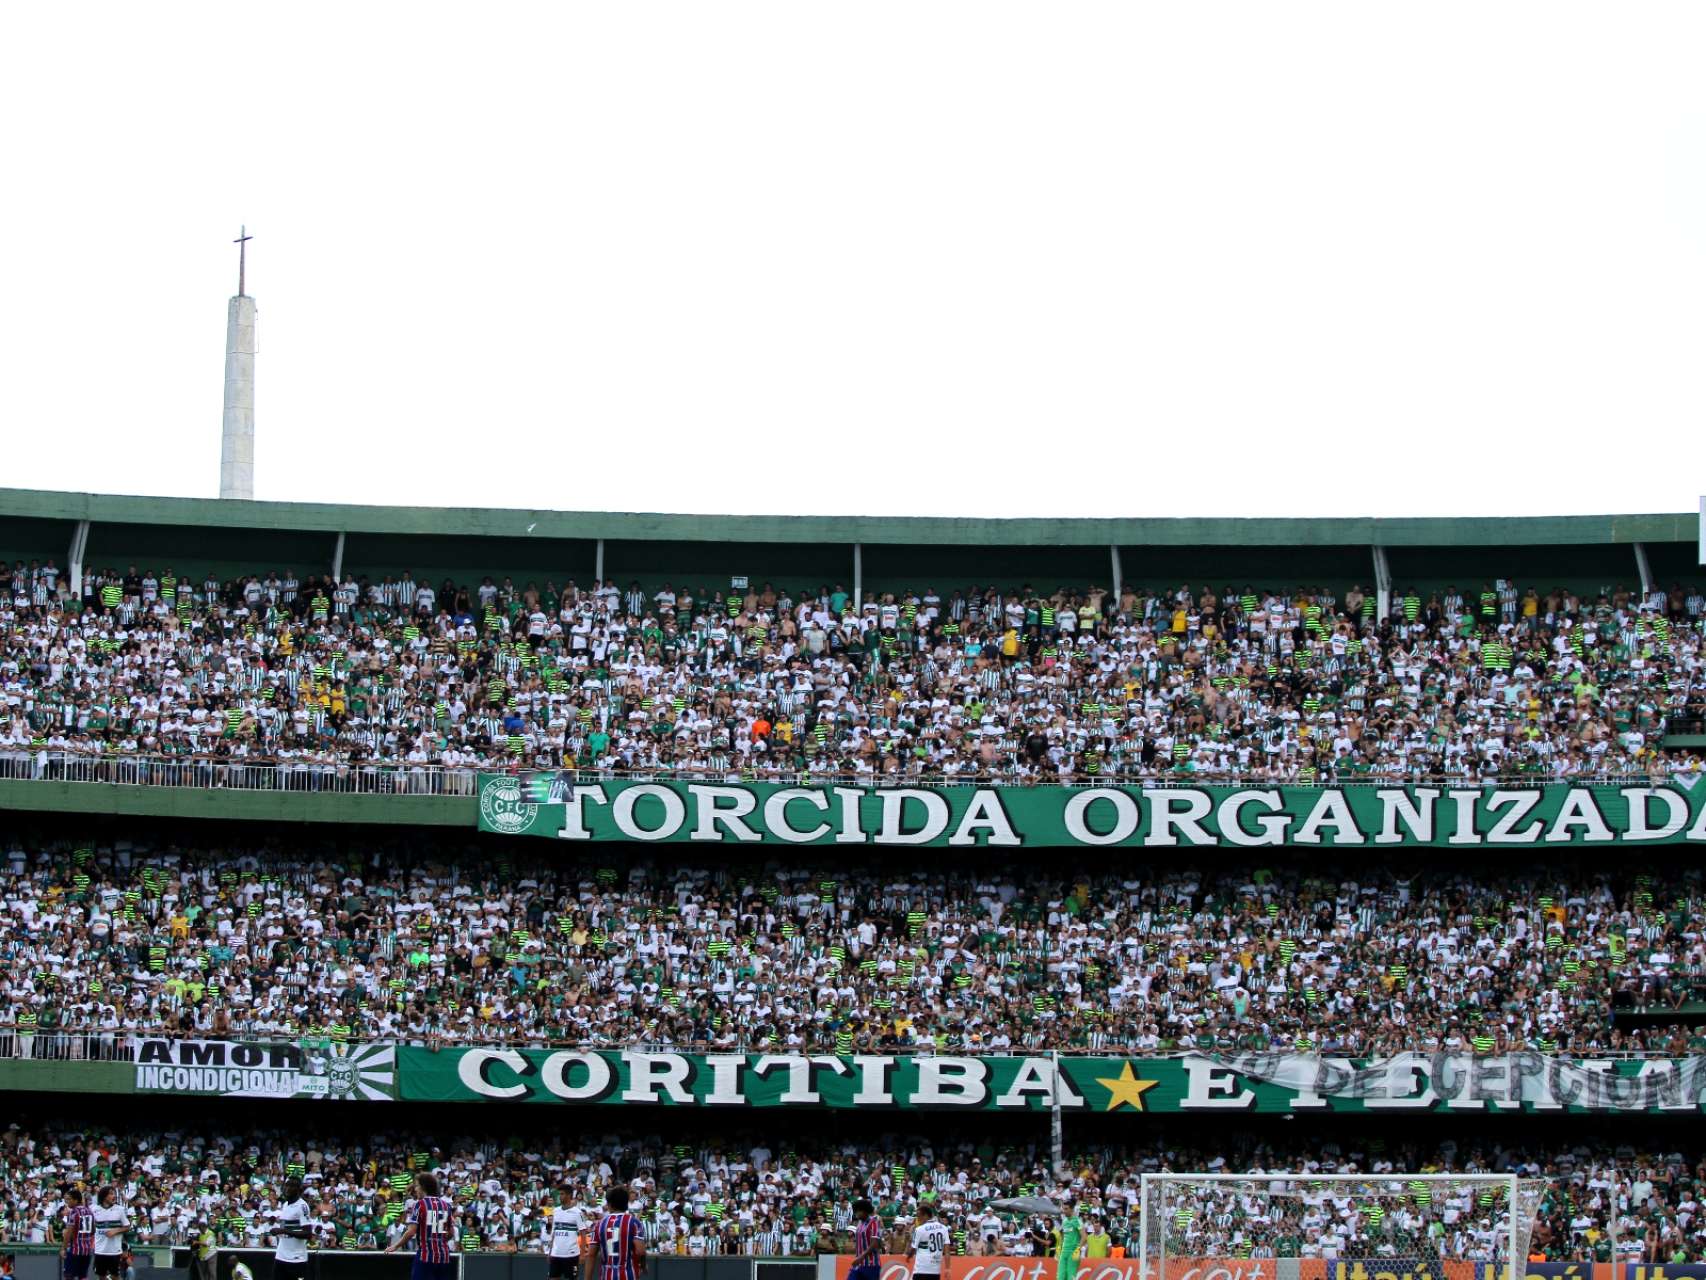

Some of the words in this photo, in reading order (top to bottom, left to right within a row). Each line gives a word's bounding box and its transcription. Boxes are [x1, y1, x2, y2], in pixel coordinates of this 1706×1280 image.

[495, 800, 525, 815] CFC
[558, 784, 1021, 845] TORCIDA
[458, 1048, 1084, 1105] CORITIBA
[929, 1232, 943, 1252] 30
